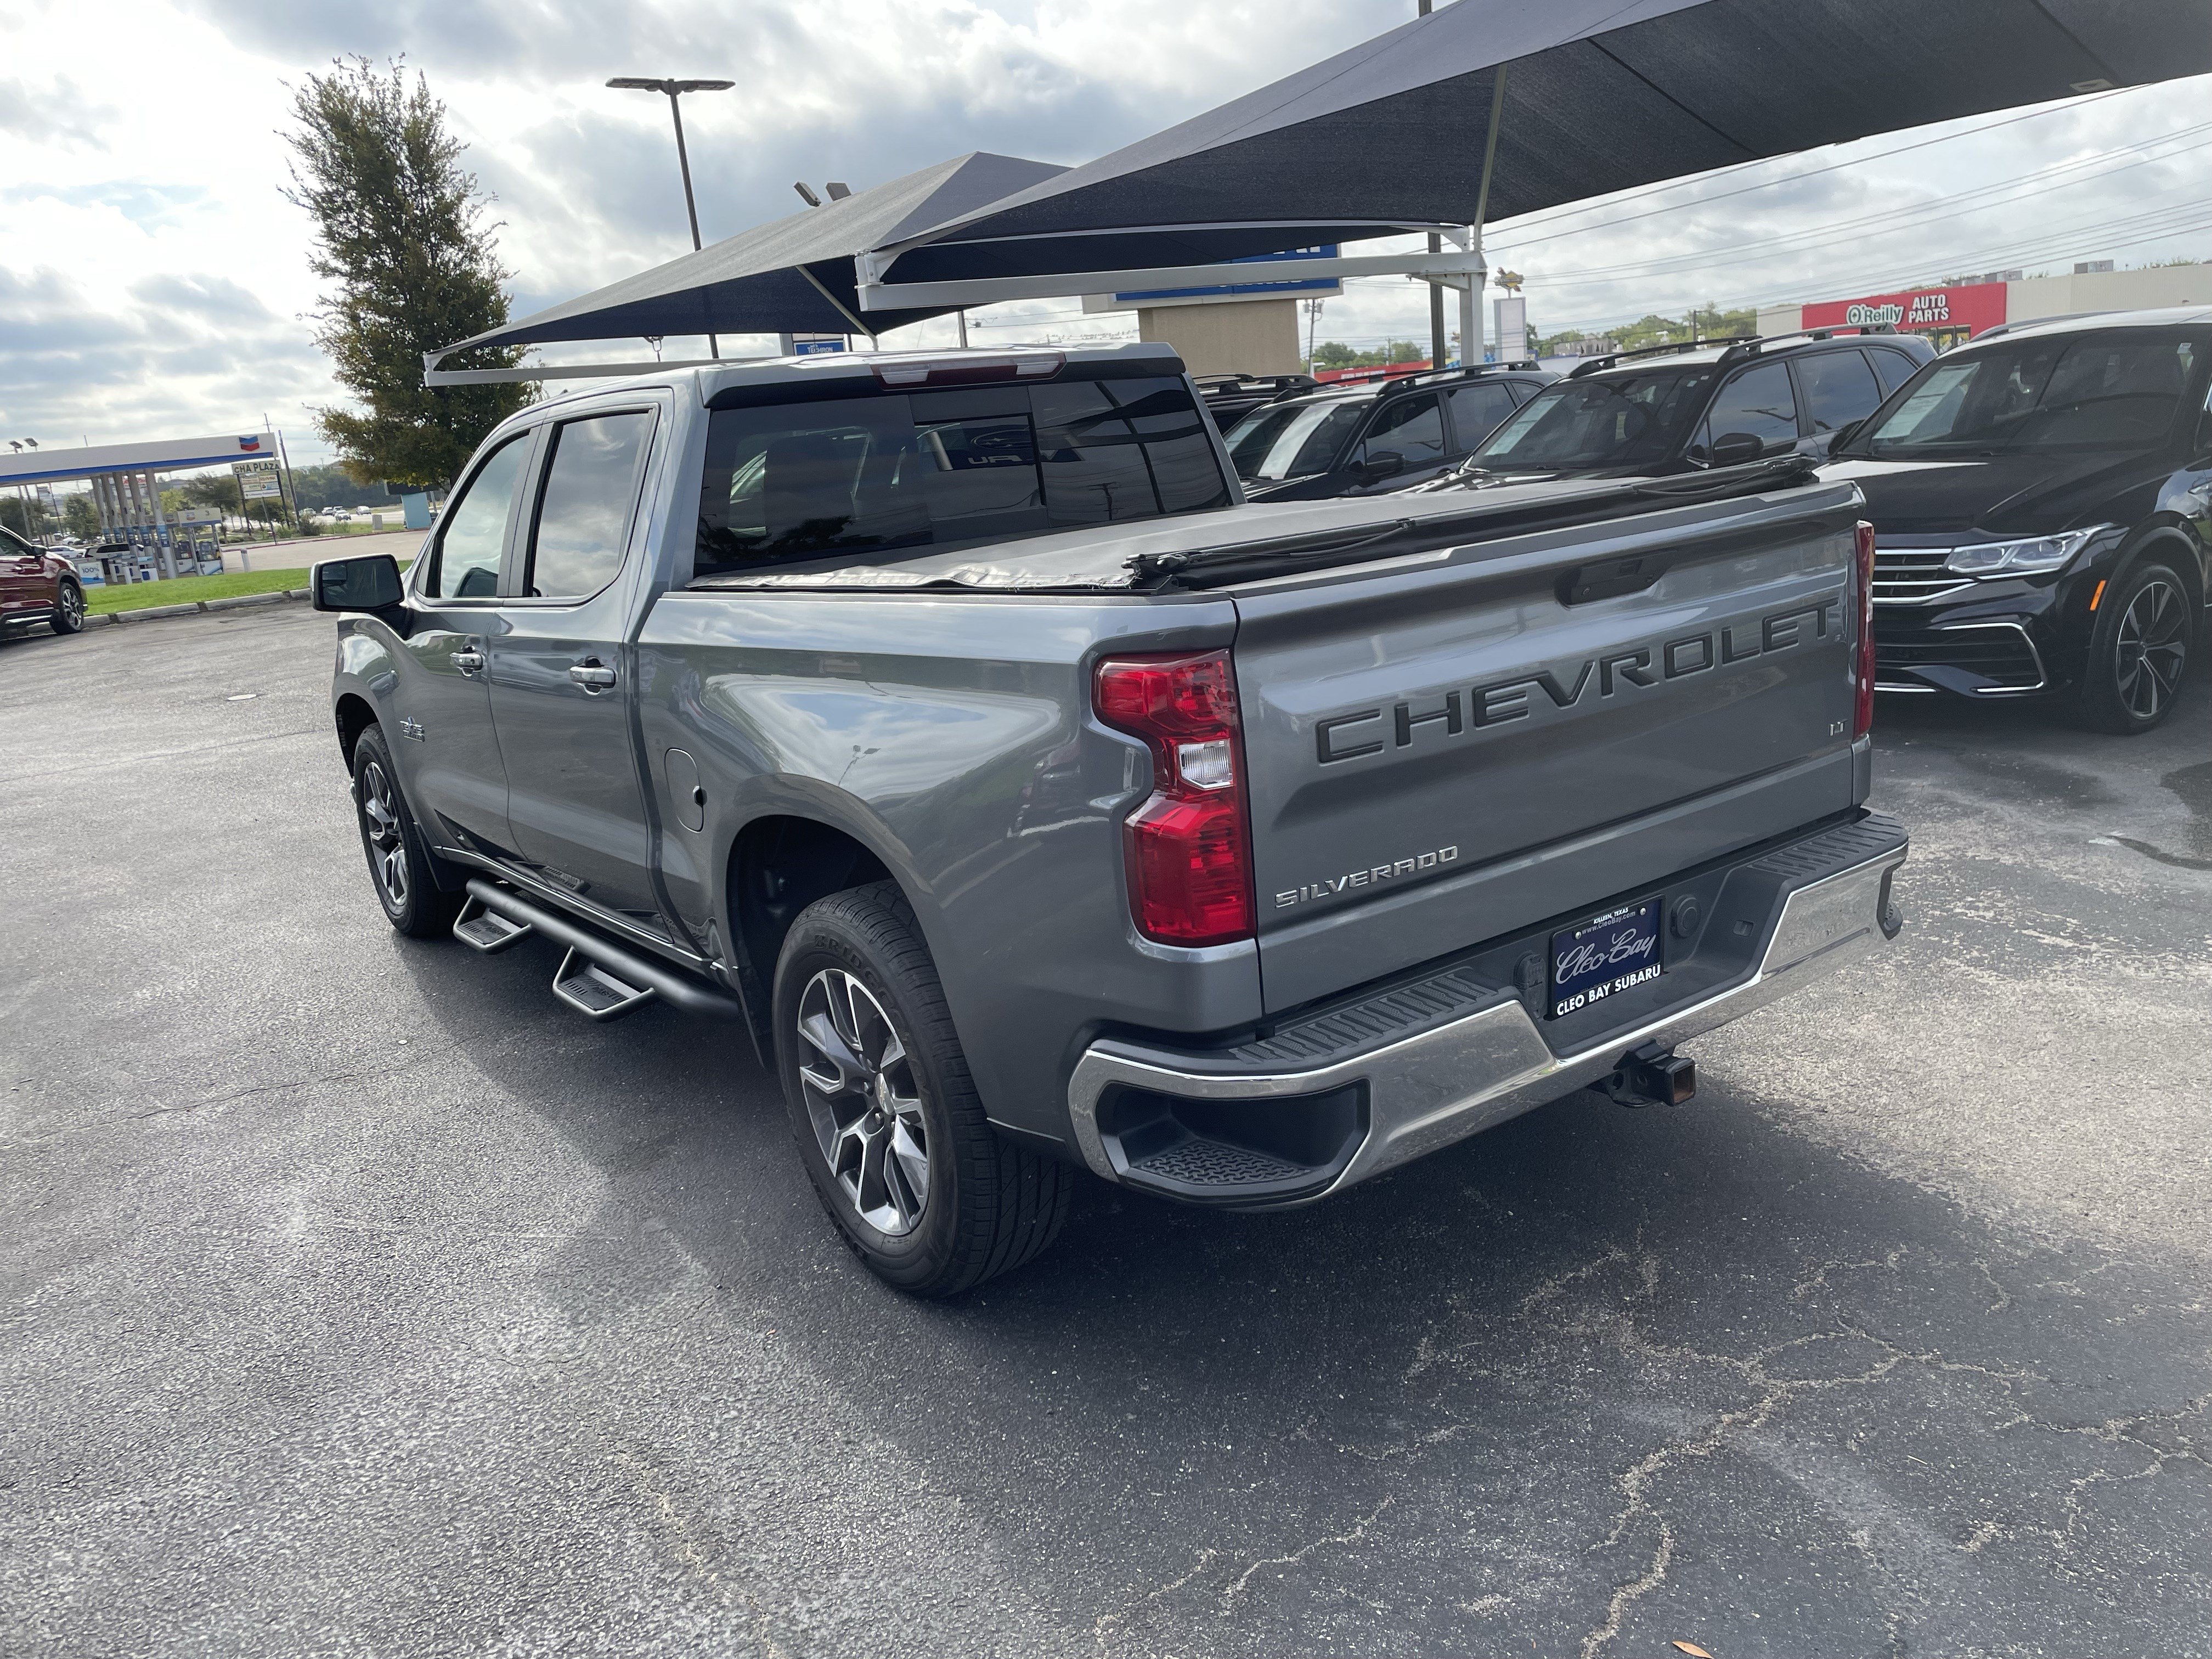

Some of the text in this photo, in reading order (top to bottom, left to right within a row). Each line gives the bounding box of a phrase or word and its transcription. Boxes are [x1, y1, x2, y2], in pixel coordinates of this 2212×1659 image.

[1912, 294, 1946, 310] AUTO
[1847, 304, 1904, 325] O'Reilly
[1909, 307, 1949, 324] PARTS
[234, 462, 280, 473] CHA PLAZA
[1318, 600, 1842, 765] CHEVROLET
[1829, 719, 1849, 736] LT
[1275, 845, 1458, 909] SILVERADO
[1614, 907, 1629, 917] TEXAS
[1582, 911, 1636, 935] www.CleoBay.com
[1556, 928, 1656, 984] Cleo Bay
[1557, 994, 1585, 1015] CLEO
[1588, 983, 1611, 1003] BAY
[1615, 964, 1661, 992] SUBARU
